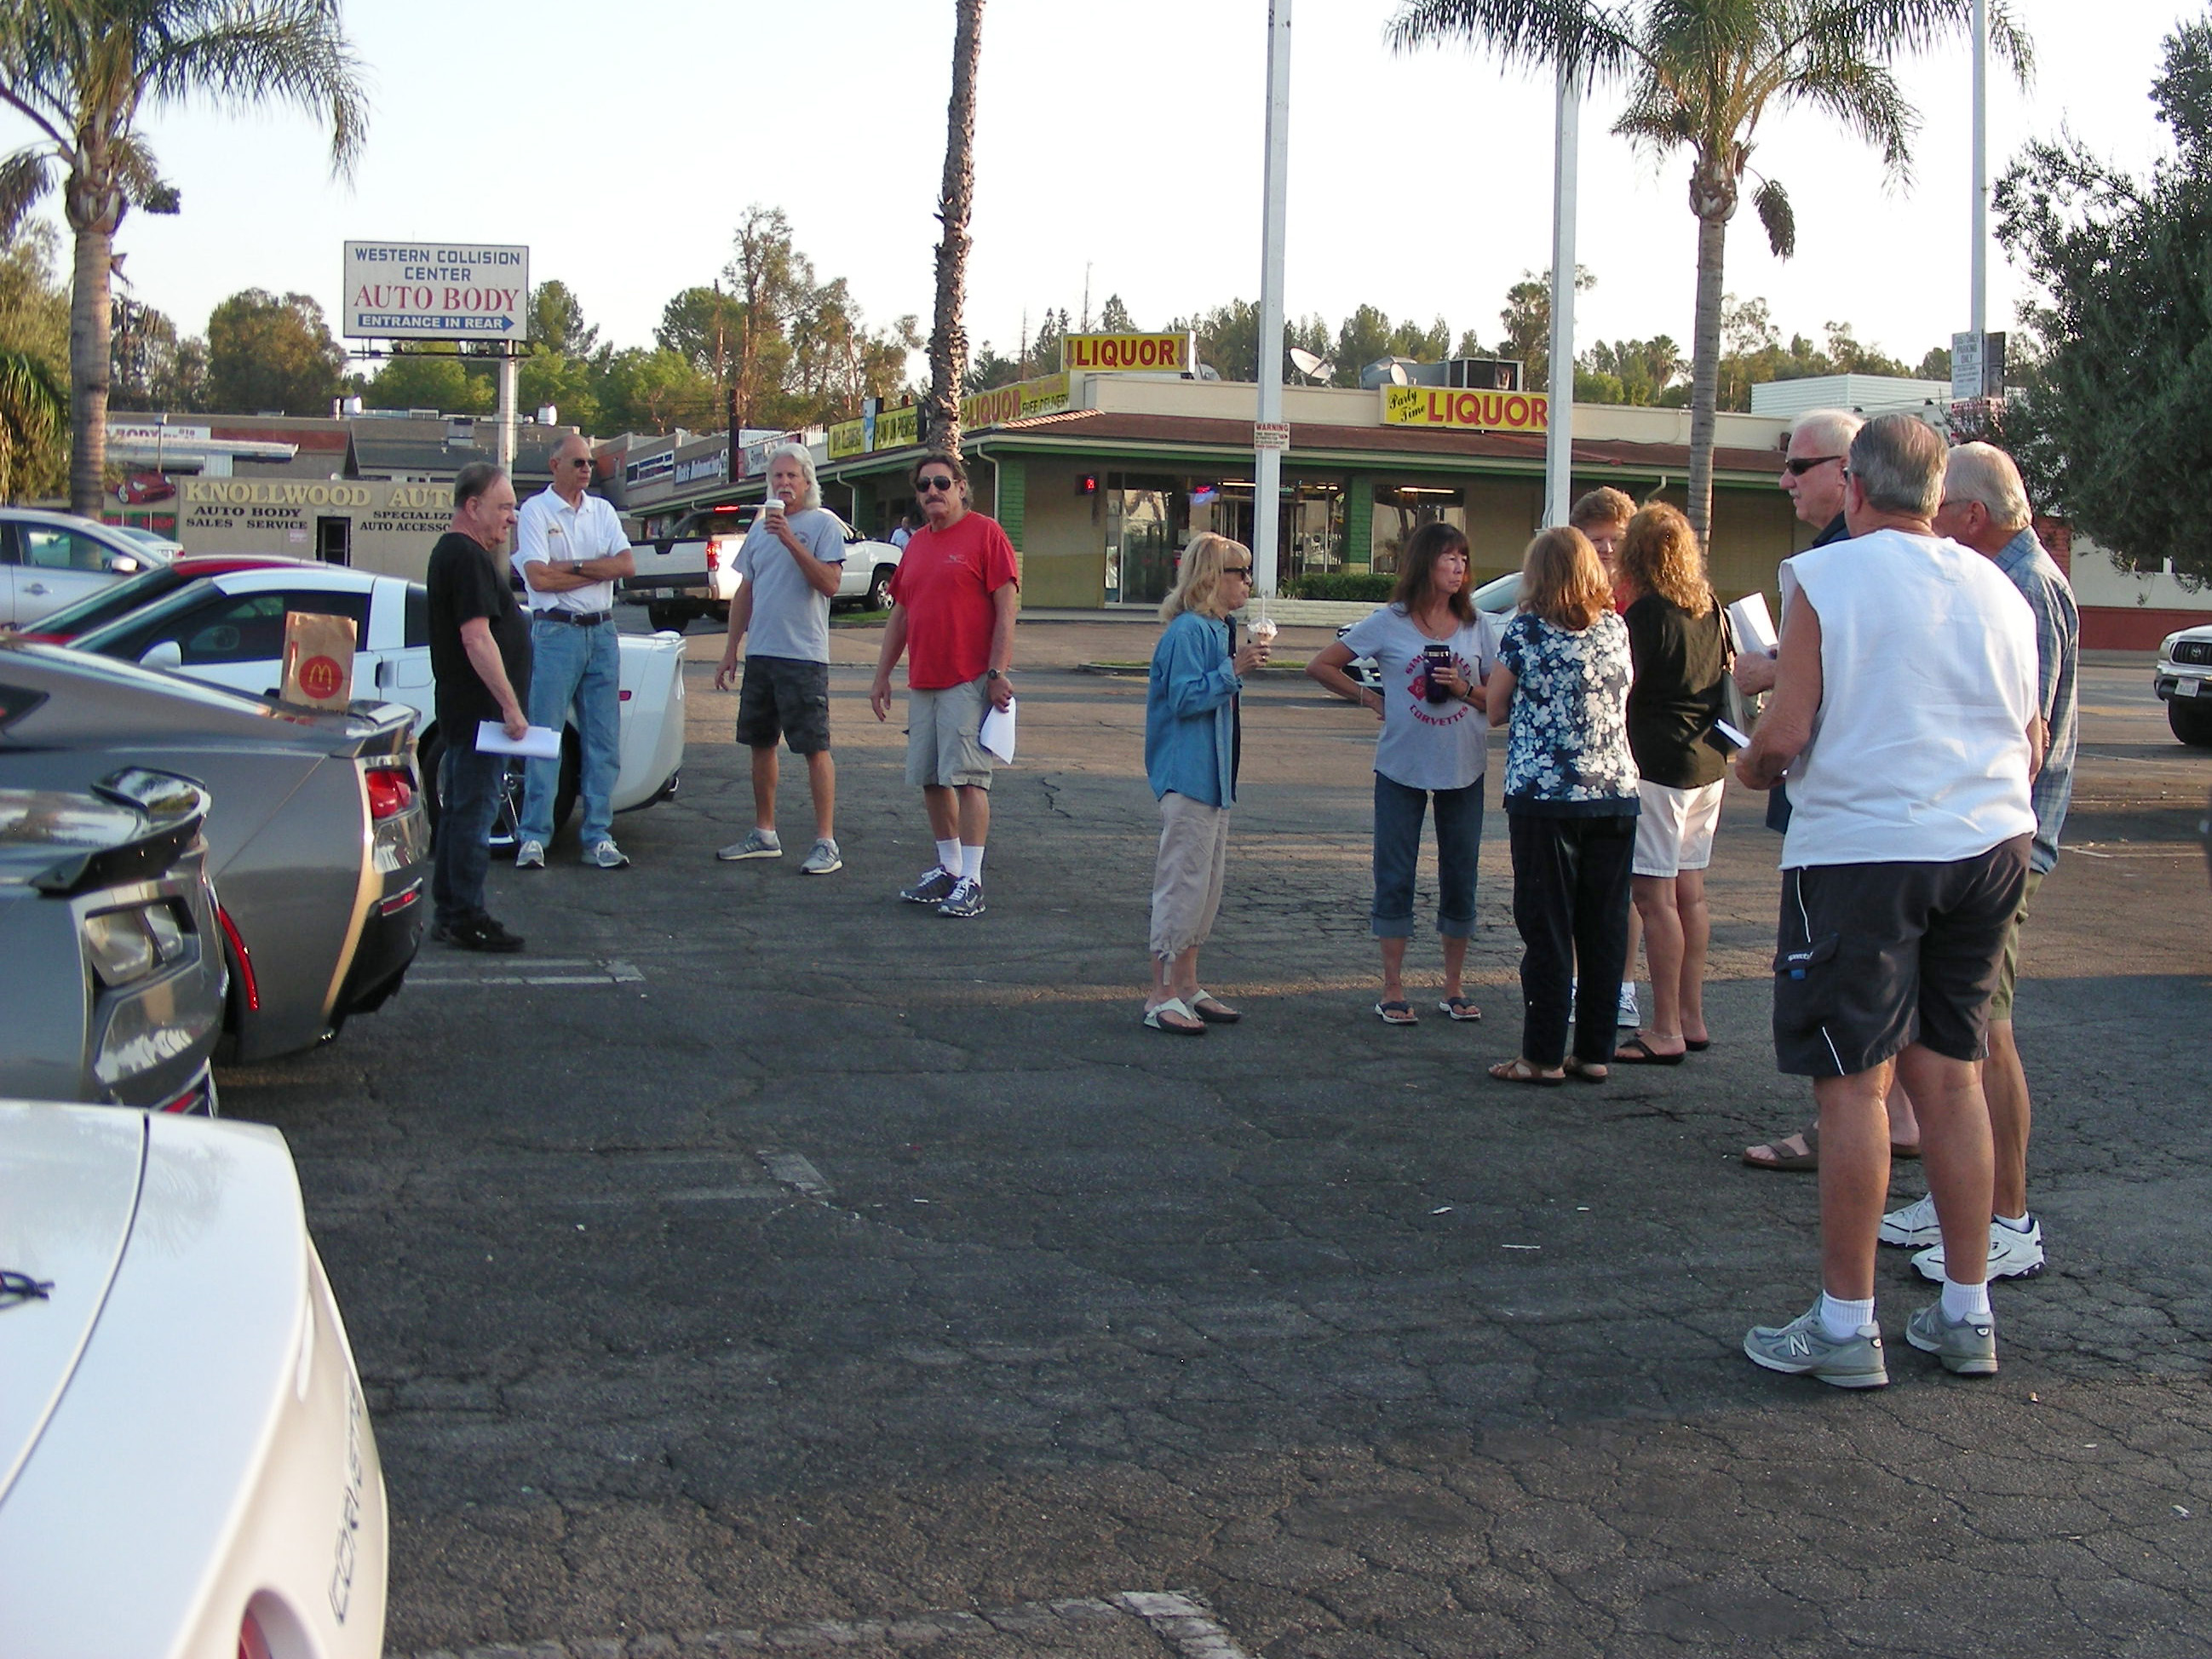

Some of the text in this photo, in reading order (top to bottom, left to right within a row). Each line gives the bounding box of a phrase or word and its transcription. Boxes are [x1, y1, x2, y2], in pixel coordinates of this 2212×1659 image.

[355, 248, 520, 265] WESTERN COLLISION
[405, 267, 471, 281] CENTER
[353, 284, 520, 312] AUTO BODY
[362, 315, 503, 329] ENTRANCE IN REAR
[1076, 340, 1175, 366] LIQUOR
[968, 389, 1021, 426] LIQUOR
[1388, 388, 1418, 409] Party
[1400, 404, 1426, 422] Time
[1428, 393, 1548, 427] LIQUOR
[185, 481, 454, 508] KNOLLWOOD AUT
[194, 506, 302, 517] AUTO BODY
[187, 518, 307, 530] SALES SERVICE
[359, 521, 393, 531] AUTO
[1405, 653, 1425, 675] SIM
[1410, 704, 1468, 726] CORVETTES
